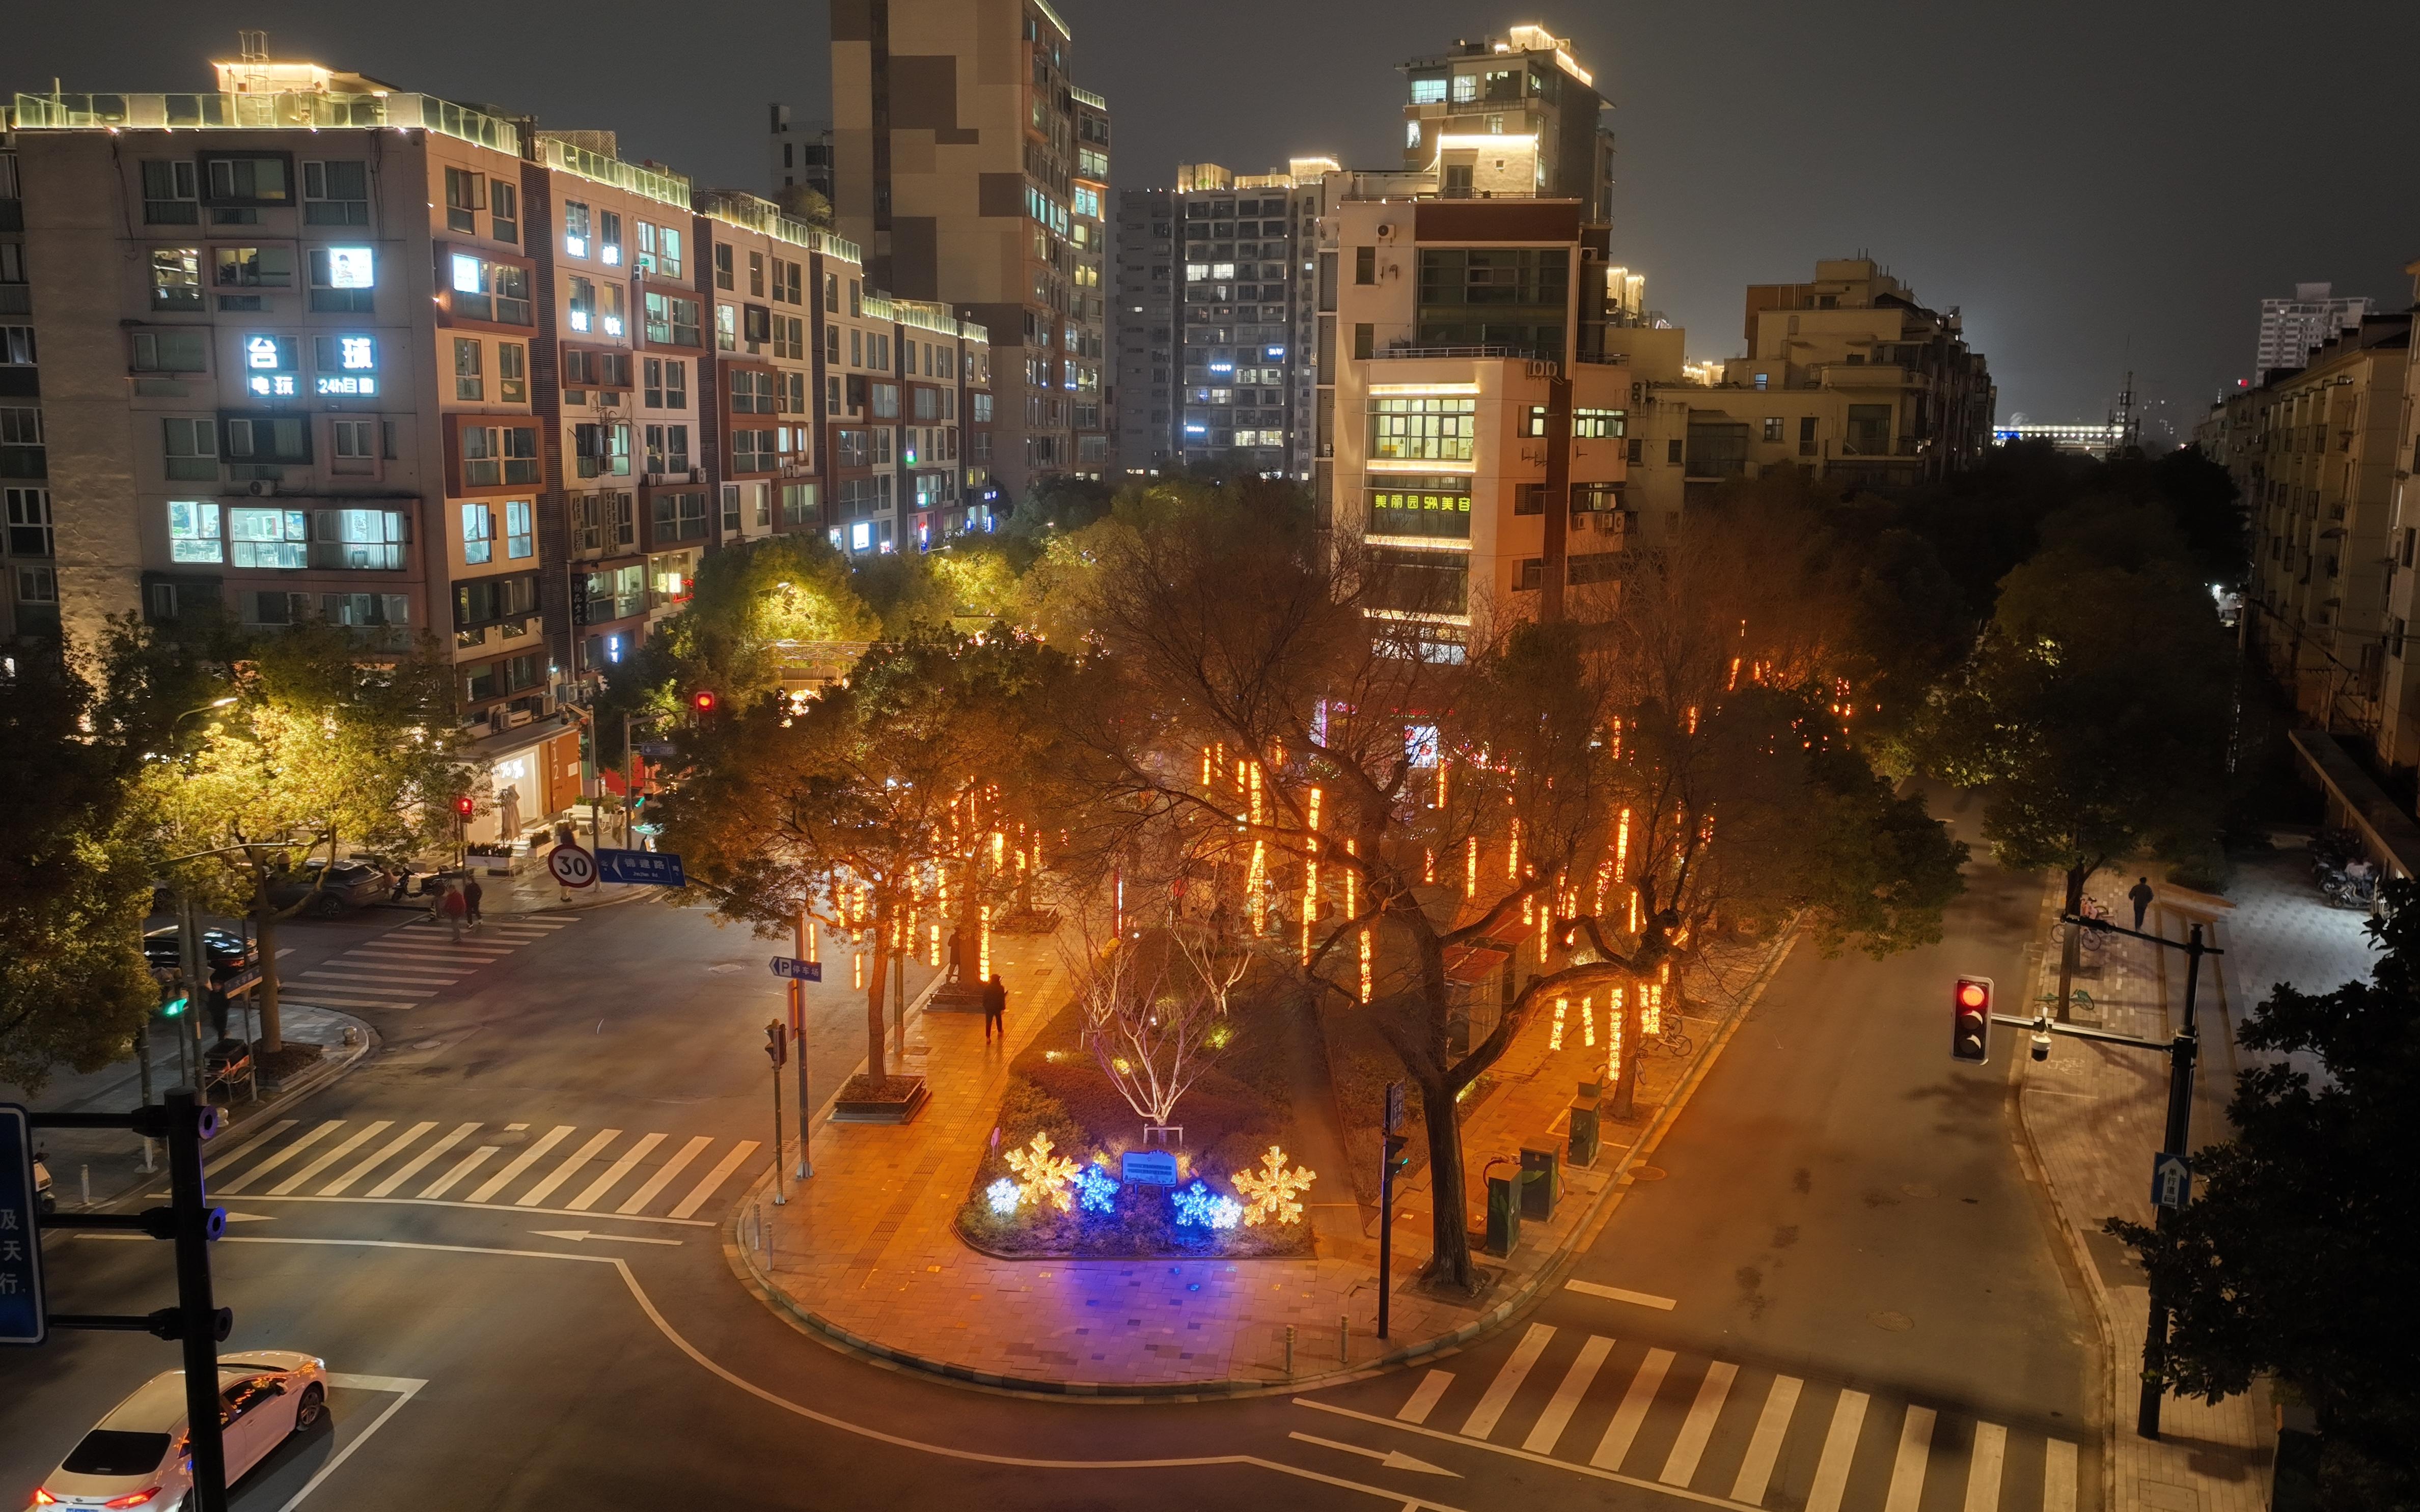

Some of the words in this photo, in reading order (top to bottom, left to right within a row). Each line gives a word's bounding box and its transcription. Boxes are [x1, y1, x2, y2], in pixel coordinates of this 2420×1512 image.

[558, 855, 588, 877] 30
[782, 962, 790, 973] P
[792, 965, 819, 977] 停车场
[2166, 1168, 2177, 1194] 单行道
[0, 1240, 22, 1262] 天
